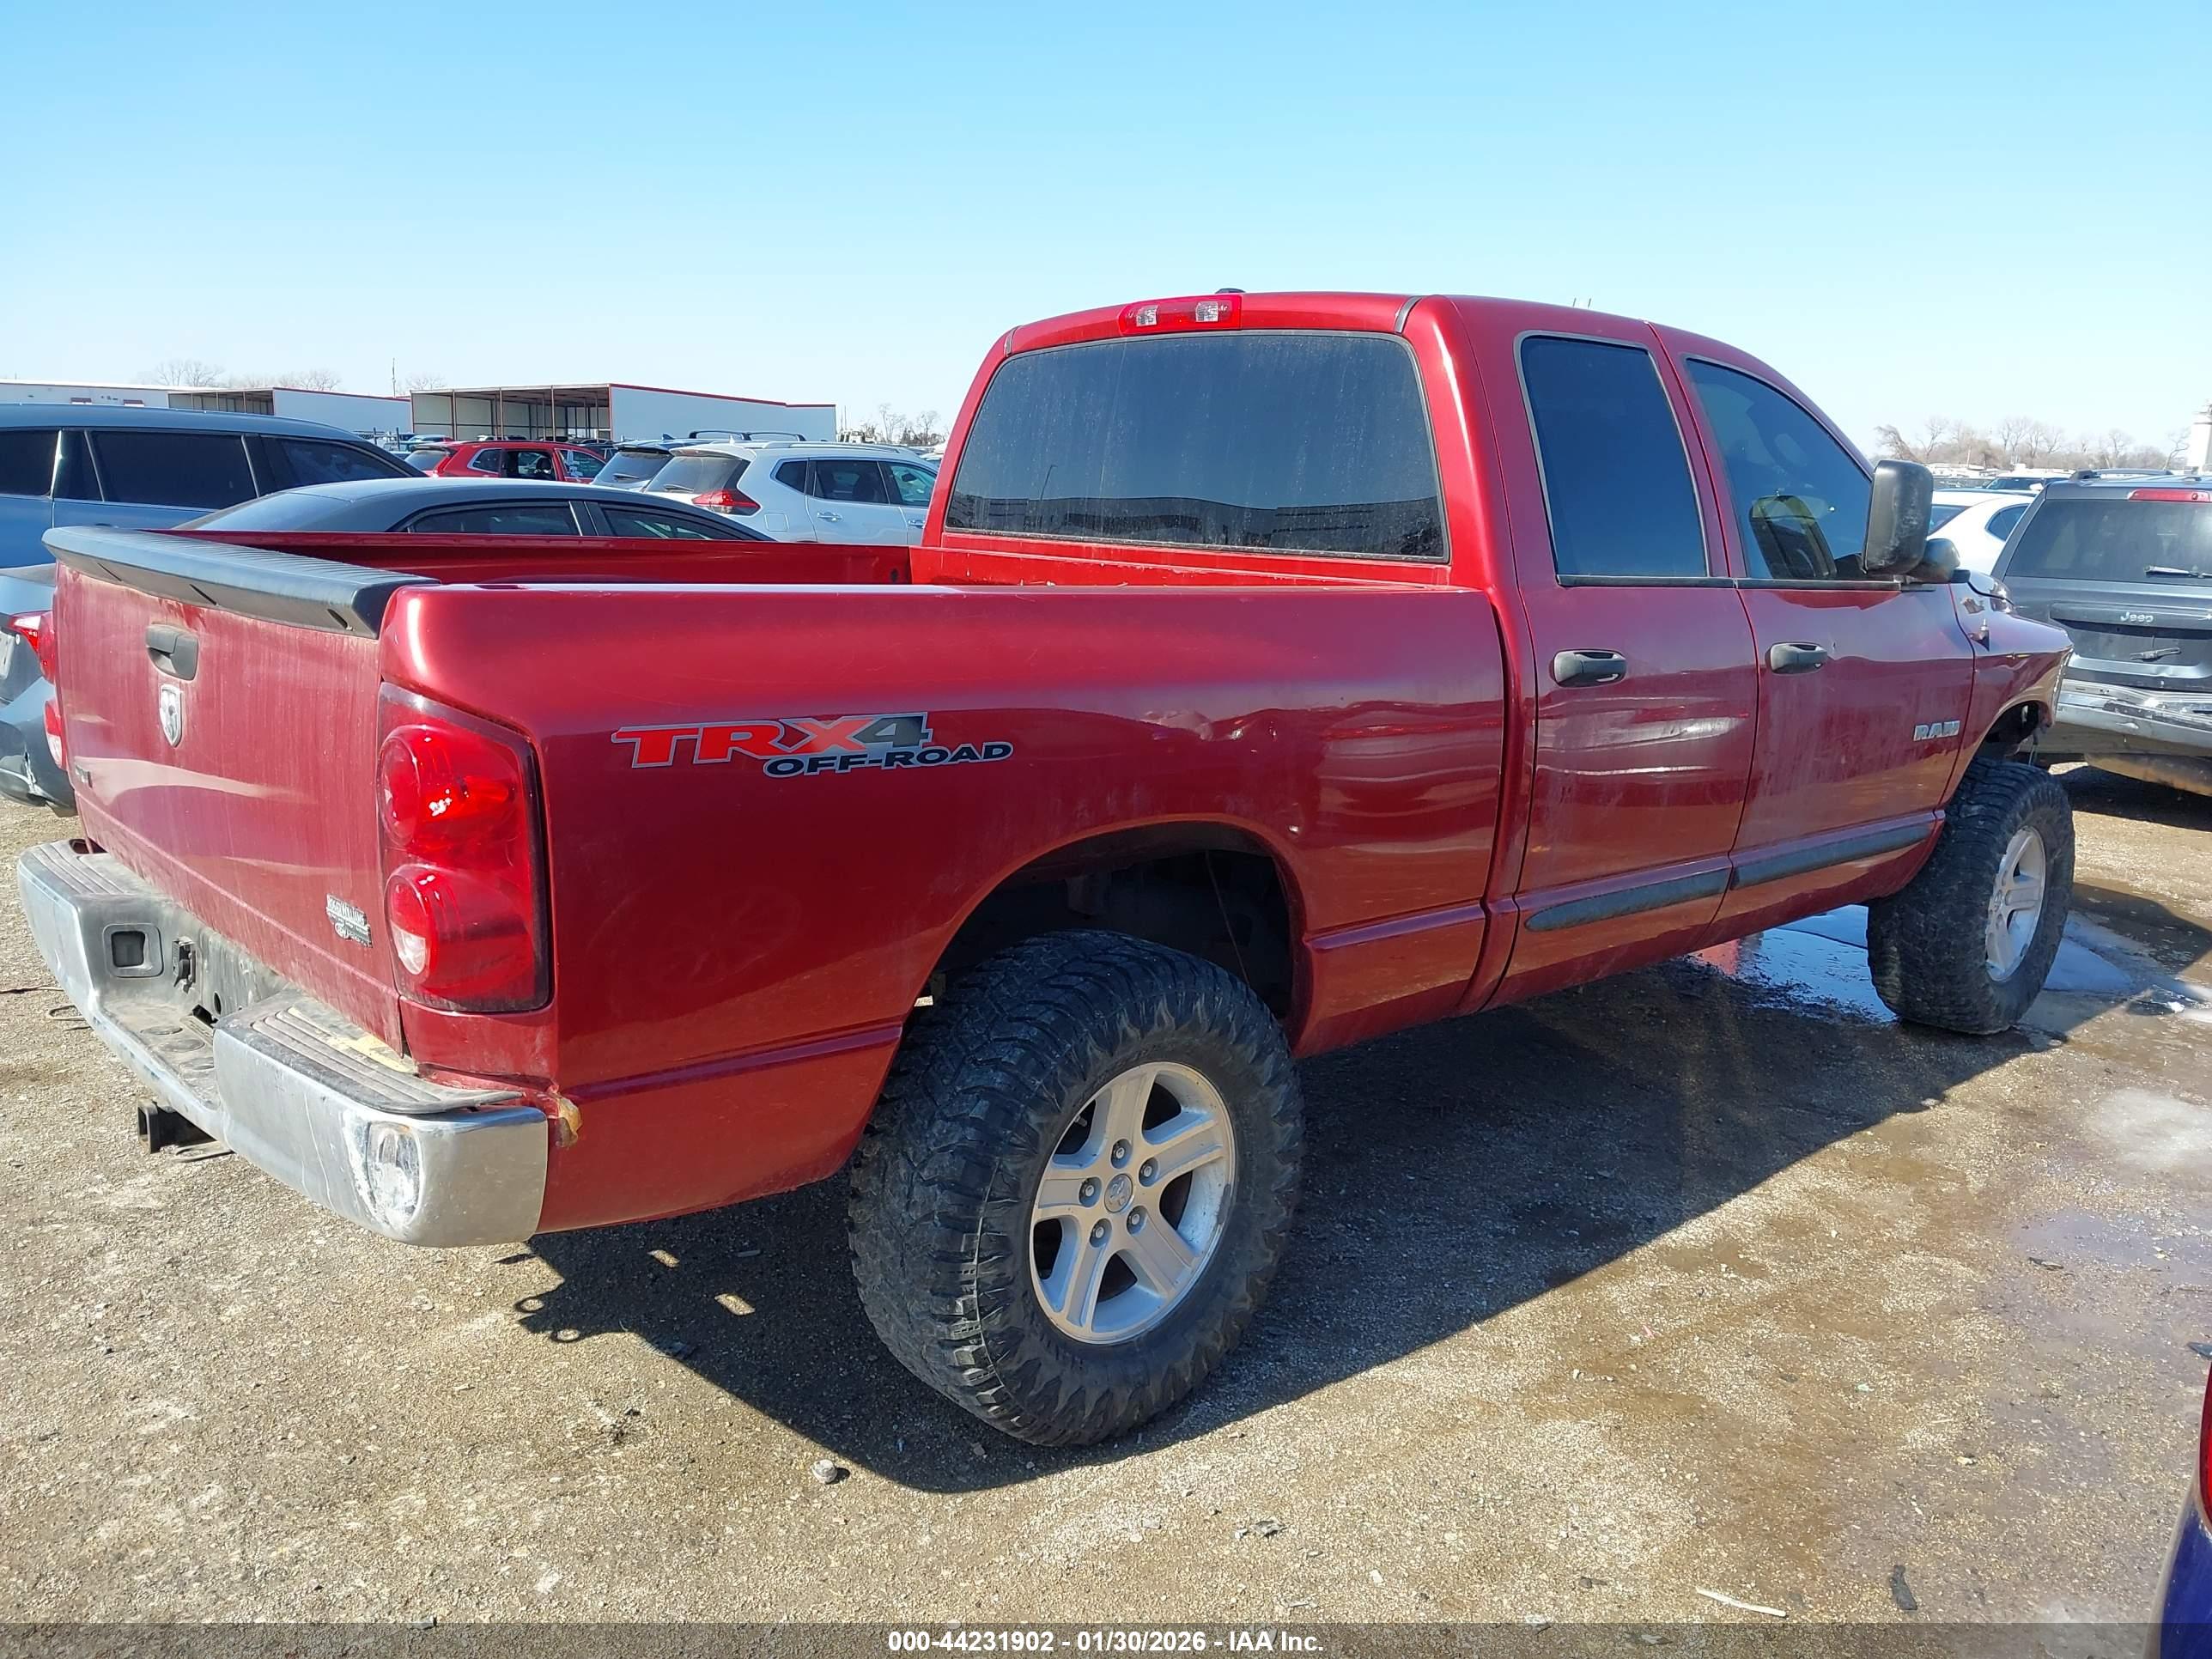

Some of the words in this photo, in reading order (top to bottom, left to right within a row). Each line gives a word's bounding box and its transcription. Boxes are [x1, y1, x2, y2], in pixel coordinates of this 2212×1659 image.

[2120, 611, 2154, 623] Jeep
[611, 712, 933, 768] TRX4
[1913, 720, 1960, 741] RAM
[764, 742, 1013, 777] OFF-ROAD
